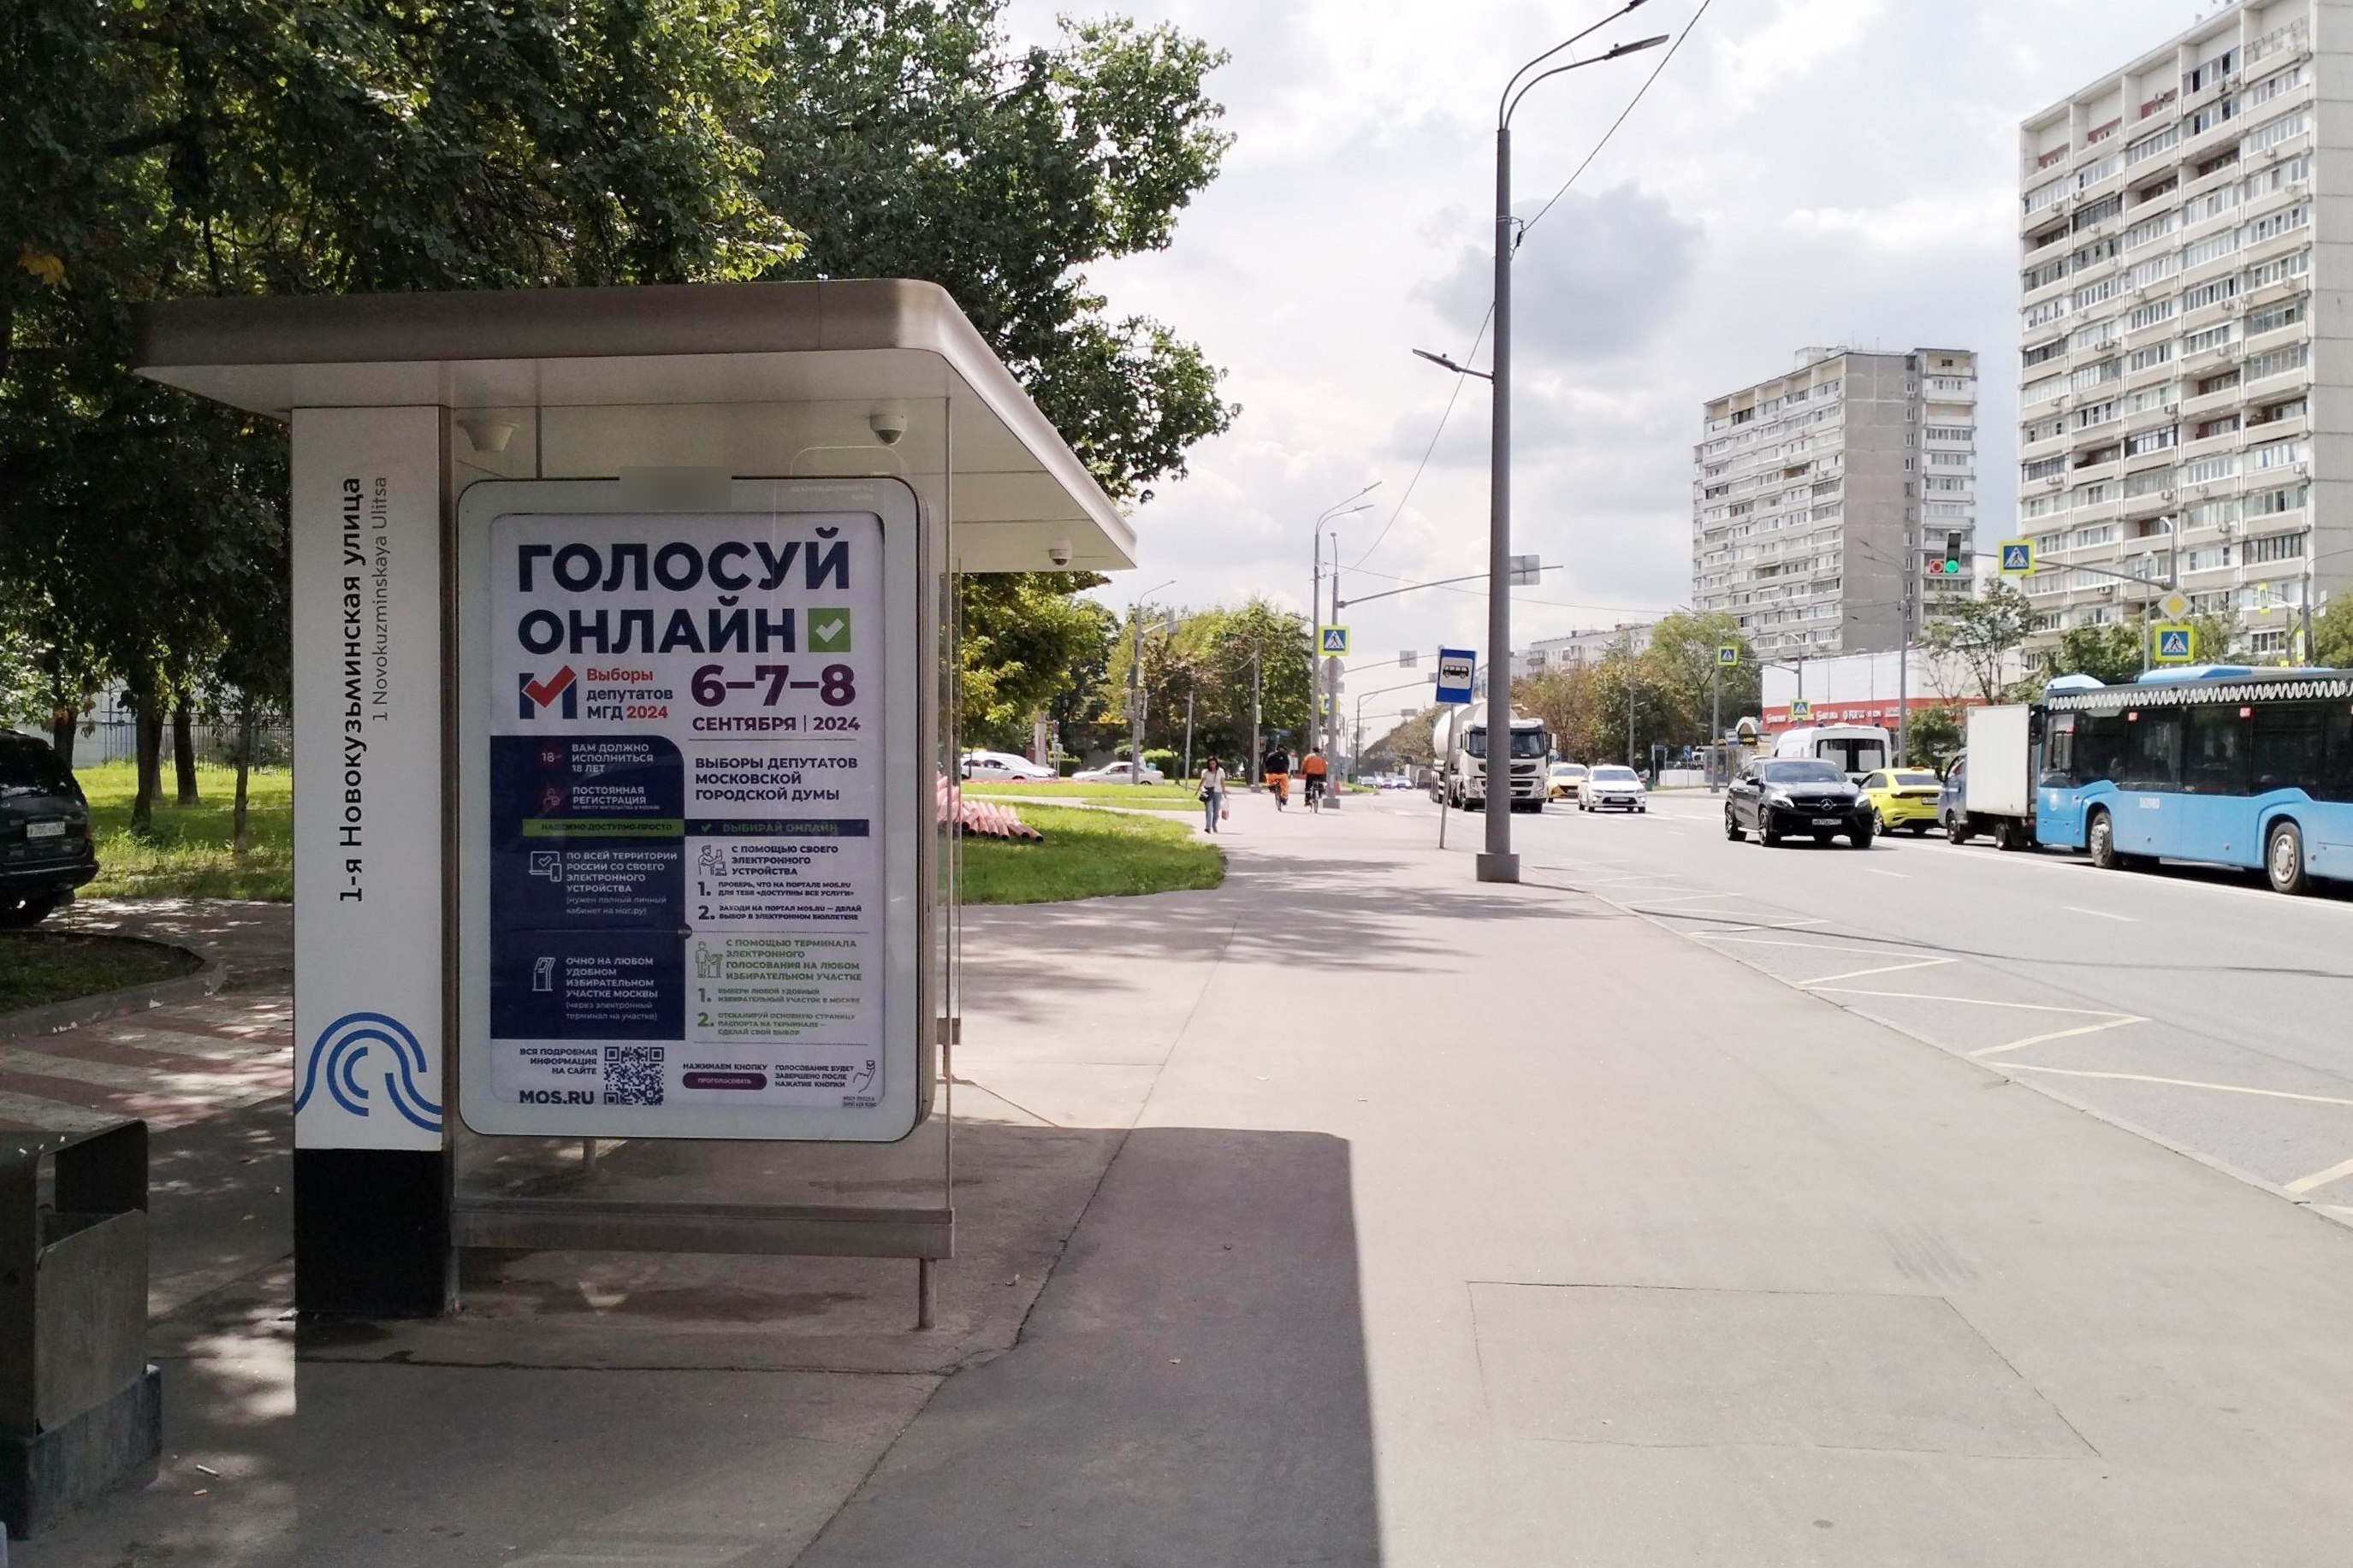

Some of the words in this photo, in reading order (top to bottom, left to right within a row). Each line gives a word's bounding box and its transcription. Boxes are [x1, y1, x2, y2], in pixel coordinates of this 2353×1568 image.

[371, 476, 388, 530] Ulitsa
[342, 476, 366, 566] улица
[519, 526, 850, 593] ГОЛОСУЙ
[372, 535, 392, 706] Novokuzminskaya
[518, 595, 796, 654] ОНЛАЙН
[586, 668, 654, 683] Выборы
[586, 688, 673, 704] депутатов
[339, 577, 367, 847] Новокузьминская
[372, 710, 388, 722] 1
[587, 707, 623, 721] МГД
[626, 706, 668, 719] 2024
[692, 716, 797, 731] СЕНТЯБРЯ
[813, 716, 861, 731] 2024
[572, 743, 596, 752] ВАМ
[599, 743, 649, 754] ДОЛЖНО
[572, 754, 654, 762] ИСПОЛНИТЬСЯ
[695, 758, 763, 768] ВЫБОРЫ
[768, 758, 858, 770] ДЕПУТАТОВ
[572, 764, 583, 772] 18
[585, 764, 606, 772] ЛЕТ
[695, 771, 801, 784] МОСКОВСКОЙ
[572, 786, 644, 795] ПОСТОЯННАЯ
[696, 787, 788, 802] ГОРОДСКОЙ
[791, 789, 839, 802] ДУМЫ
[572, 796, 646, 806] РЕГИСТРАЦИЯ
[723, 821, 783, 832] ВЫБИРАЙ
[786, 820, 838, 832] ОНЛАЙН
[566, 852, 581, 861] ПО
[584, 850, 610, 861] ВСЕЙ
[613, 852, 678, 861] ТЕРРИТОРИИ
[741, 845, 797, 855] ПОМОЩЬЮ
[732, 867, 797, 875] УСТРОЙСТВА
[339, 857, 363, 902] 1-я
[566, 884, 632, 892] УСТРОЙСТВА
[698, 881, 711, 896] 1.
[698, 905, 715, 920] 2.
[735, 939, 791, 948] ПОМОЩЬЮ
[566, 957, 596, 966] ОЧНО
[598, 957, 612, 966] НА
[613, 957, 654, 966] ЛЮБОМ
[566, 990, 611, 998] УЧАСТКЕ
[613, 990, 658, 998] МОСКВЫ
[698, 988, 712, 1003] 1.
[698, 1012, 714, 1027] 2.
[540, 1048, 597, 1056] ПОДРОБНАЯ
[567, 1066, 597, 1075] САЙТЕ
[519, 1090, 595, 1105] MOS.RU
